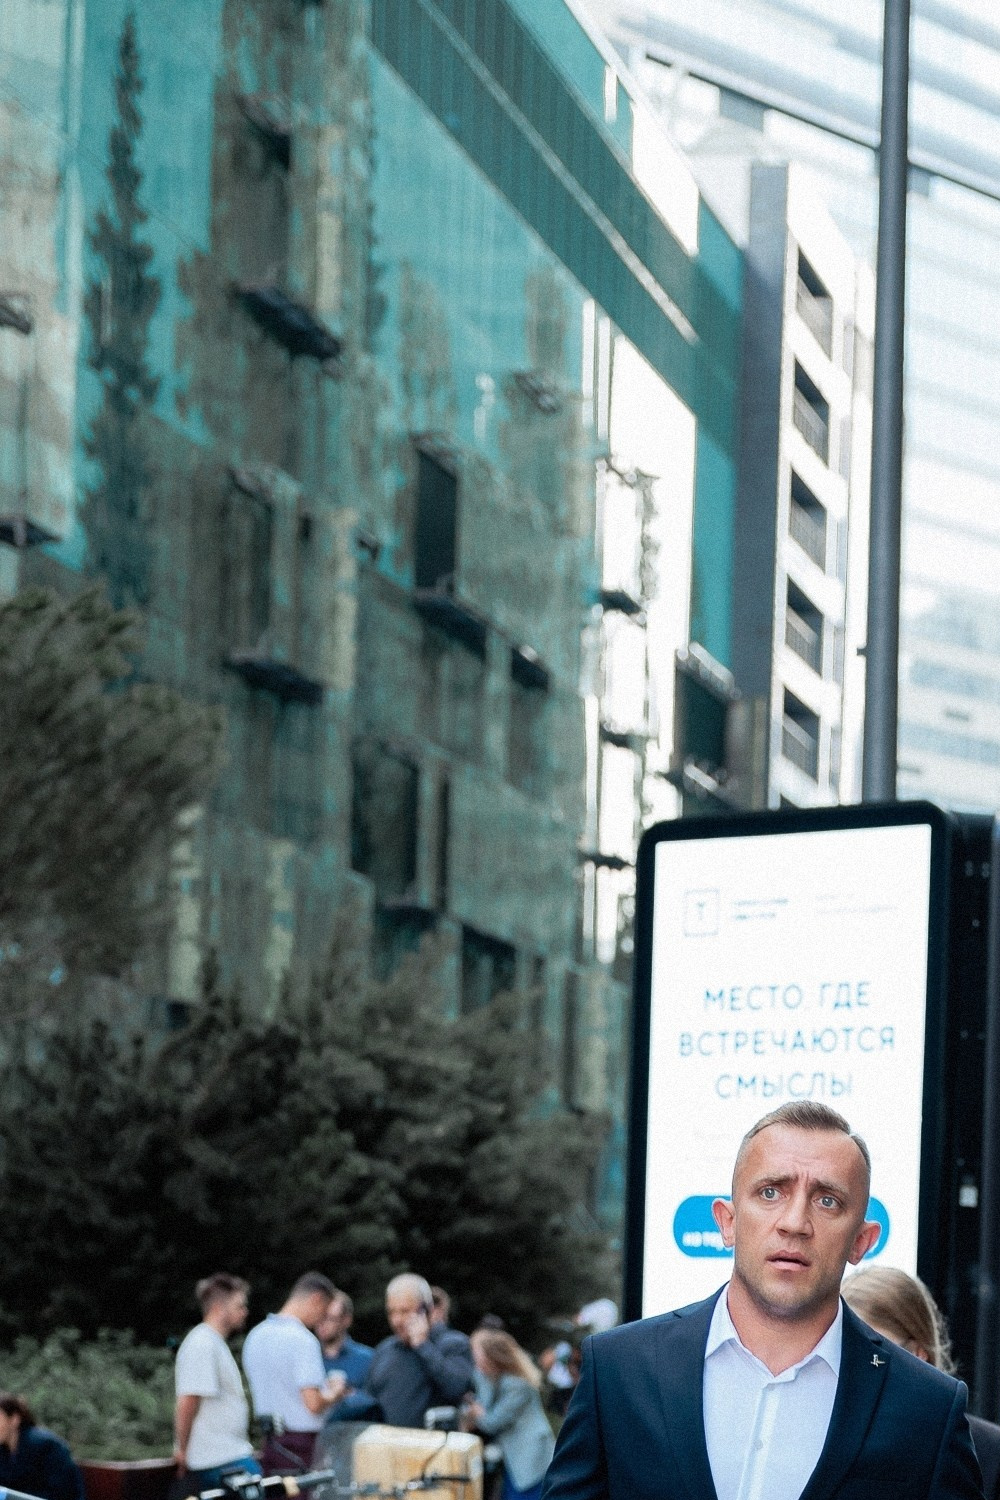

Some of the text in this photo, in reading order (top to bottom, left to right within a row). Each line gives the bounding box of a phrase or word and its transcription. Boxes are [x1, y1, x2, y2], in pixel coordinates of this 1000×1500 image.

[703, 981, 870, 1011] МЕСТО ГДЕ
[678, 1026, 896, 1057] ВСТРЕЧАЮТСЯ
[715, 1072, 853, 1099] СМЫСЛЫ
